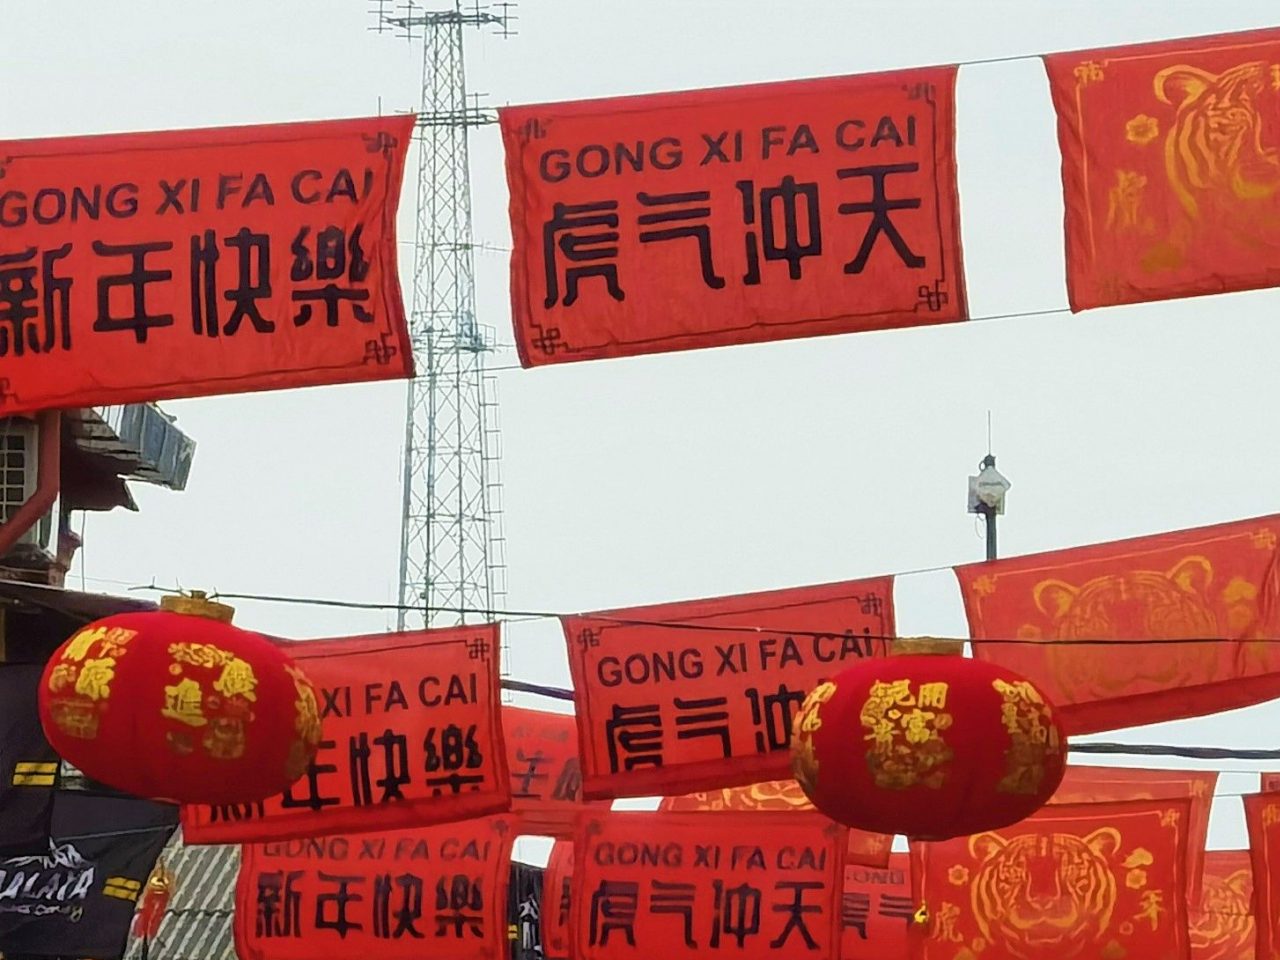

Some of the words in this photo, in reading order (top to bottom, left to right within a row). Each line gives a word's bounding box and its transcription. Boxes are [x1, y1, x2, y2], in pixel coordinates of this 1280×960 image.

[540, 137, 683, 183] GONG
[700, 130, 743, 167] XI
[761, 124, 820, 160] FA
[835, 116, 916, 151] CAI
[0, 181, 139, 230] GONG
[155, 179, 202, 217] XI
[215, 171, 275, 205] FA
[291, 165, 374, 203] CAI
[544, 162, 926, 309] 虎气冲天
[0, 225, 377, 357] 新年快樂
[596, 650, 704, 688] GONG
[716, 642, 747, 674] XI
[760, 637, 803, 670] FA
[812, 627, 874, 662] CAI
[321, 685, 352, 719] XI
[364, 680, 408, 715] FA
[418, 672, 477, 707] CAI
[357, 839, 385, 861] XI
[395, 839, 428, 861] FA
[439, 839, 490, 863] CAI
[593, 841, 682, 870] GONG
[693, 843, 720, 868] XI
[731, 843, 766, 870] FA
[776, 844, 827, 872] CAI
[256, 869, 484, 939] 新年快樂
[588, 878, 825, 950] 虎气冲天
